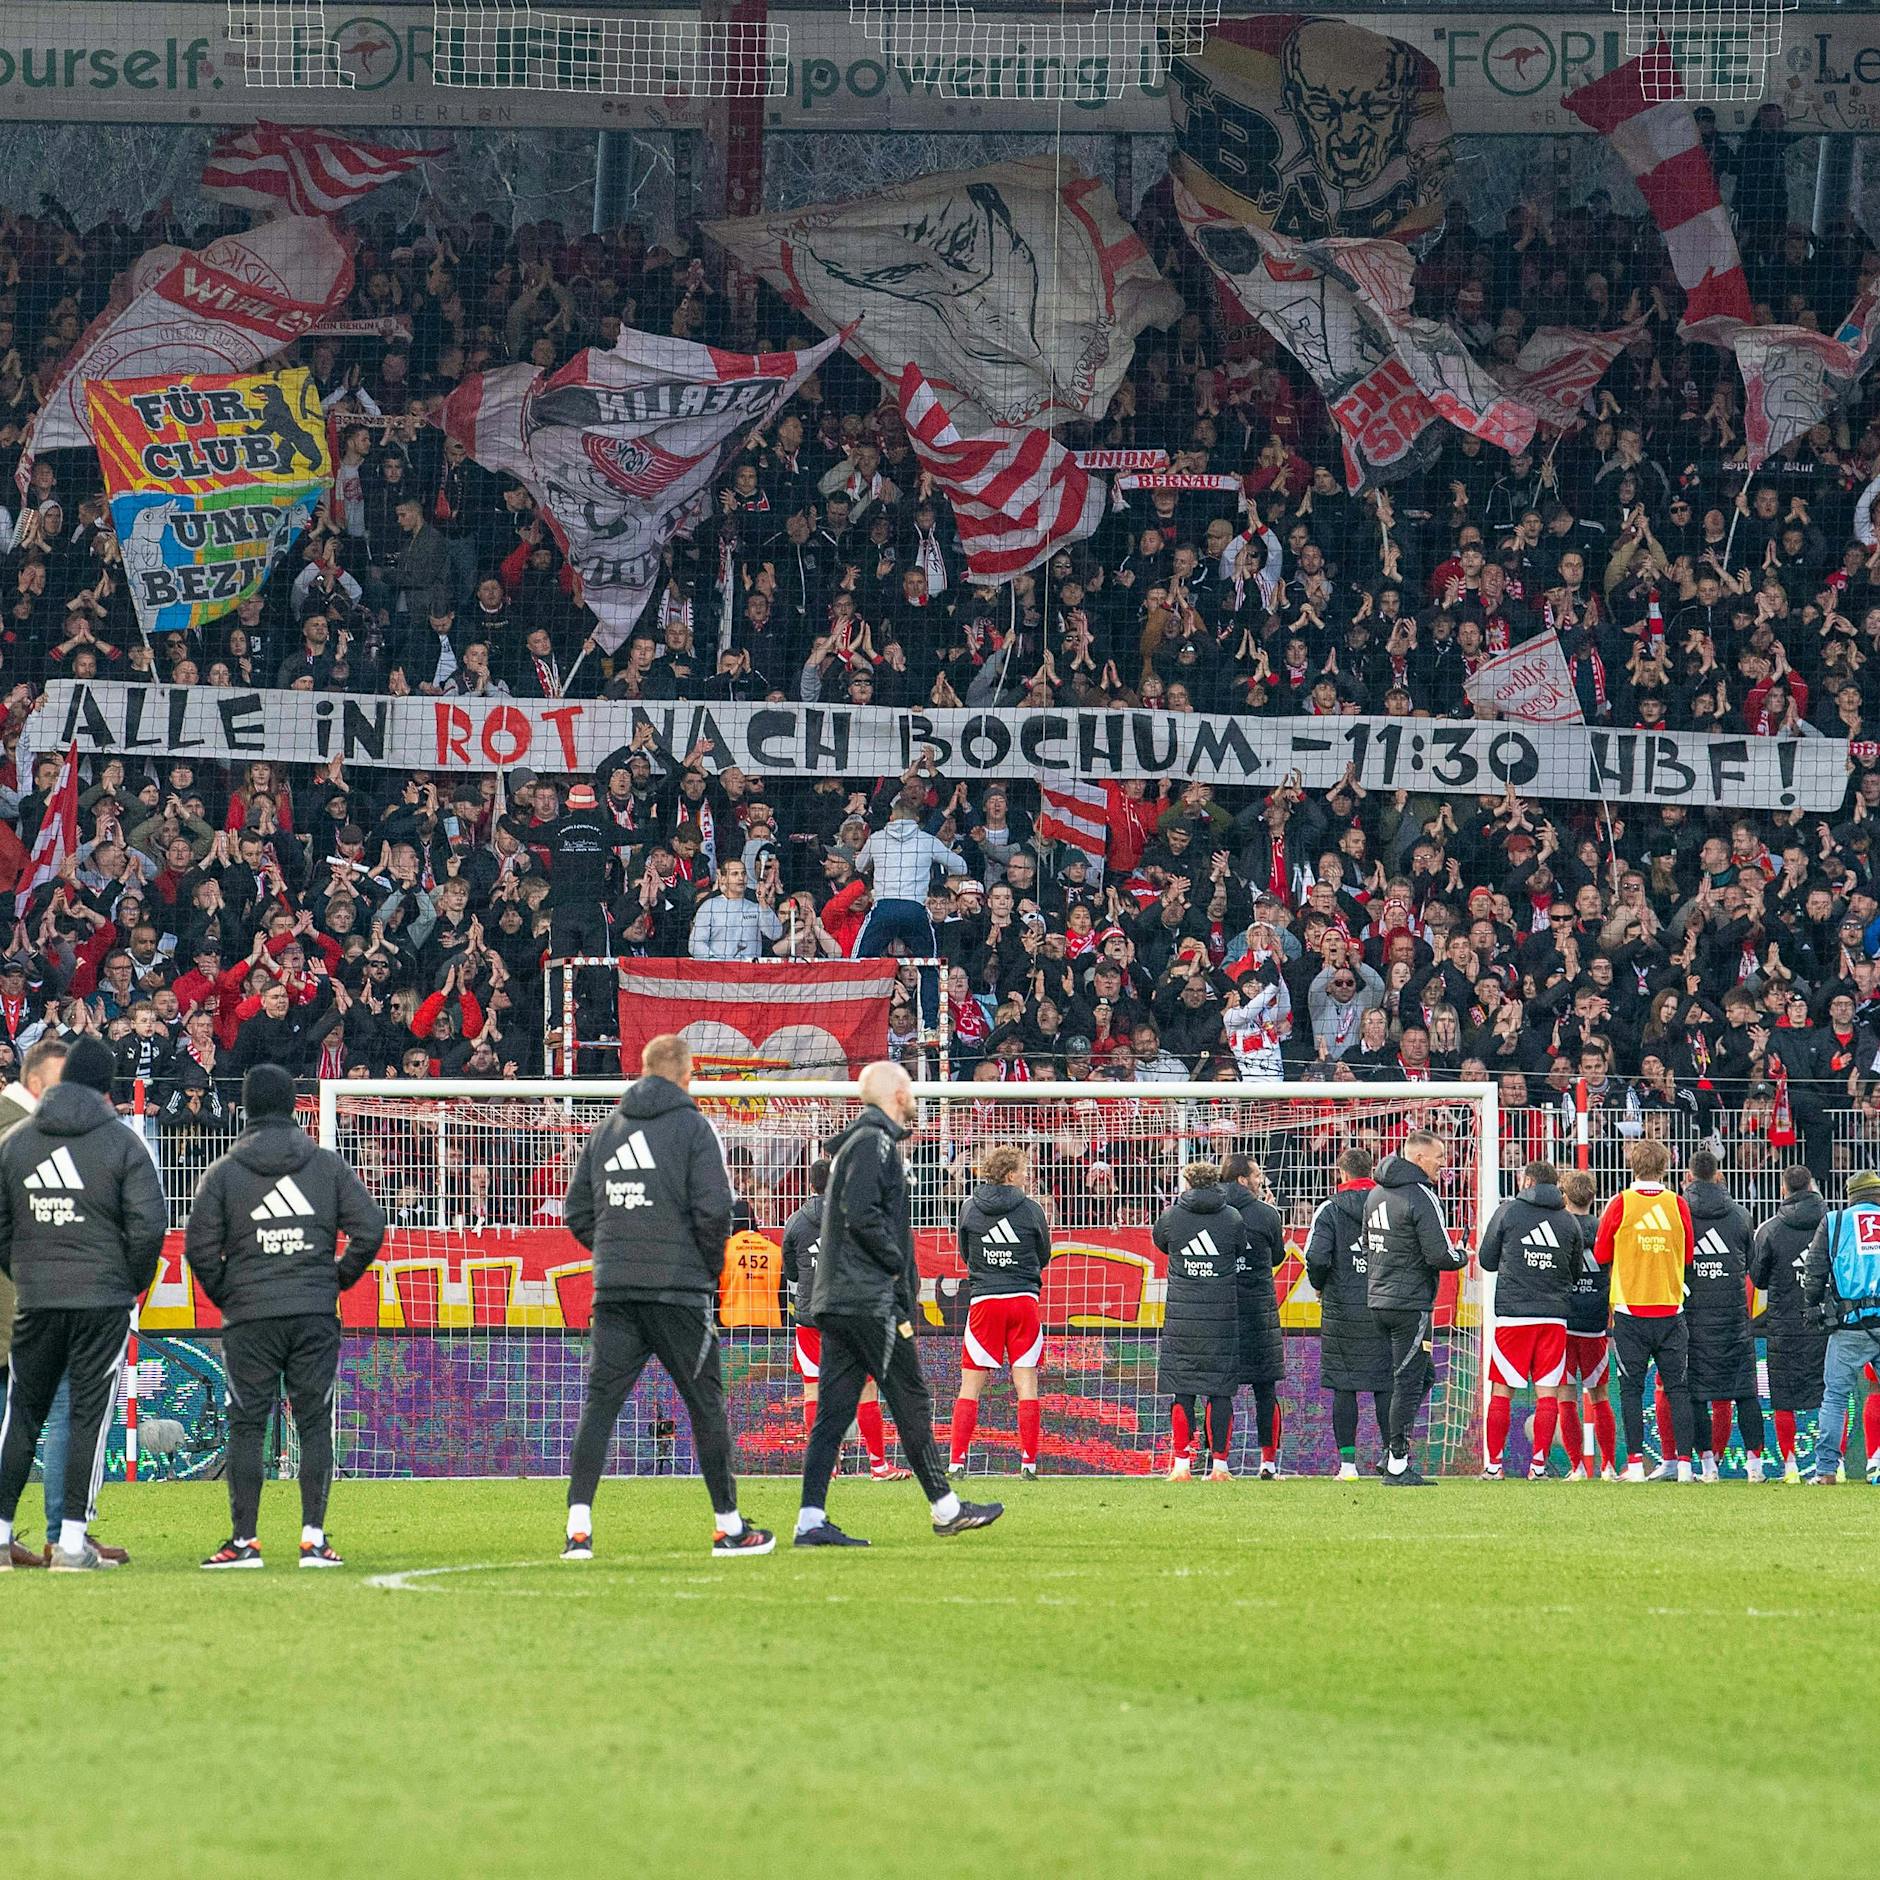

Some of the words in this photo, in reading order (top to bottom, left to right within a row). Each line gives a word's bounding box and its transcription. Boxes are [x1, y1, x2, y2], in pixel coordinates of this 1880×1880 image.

[143, 436, 278, 480] CLUB
[1083, 450, 1157, 467] UNION
[1138, 474, 1221, 488] BERNAU
[61, 683, 265, 751] ALLE
[434, 702, 584, 770] ROT
[631, 704, 852, 771] NACH
[899, 711, 1262, 777] BOCHUM
[605, 1180, 645, 1196] home
[29, 1194, 75, 1211] home
[609, 1193, 624, 1207] to
[36, 1207, 52, 1222] to
[256, 1228, 304, 1244] home
[1637, 1234, 1666, 1245] home
[263, 1239, 281, 1254] to
[983, 1247, 1013, 1258] home
[1642, 1242, 1650, 1251] to
[986, 1256, 998, 1266] to
[1523, 1249, 1553, 1260] home
[738, 1255, 768, 1269] 452
[1184, 1259, 1213, 1270] home
[1527, 1257, 1538, 1268] to
[1693, 1260, 1723, 1270] home
[1187, 1267, 1198, 1277] to
[1697, 1268, 1708, 1277] to
